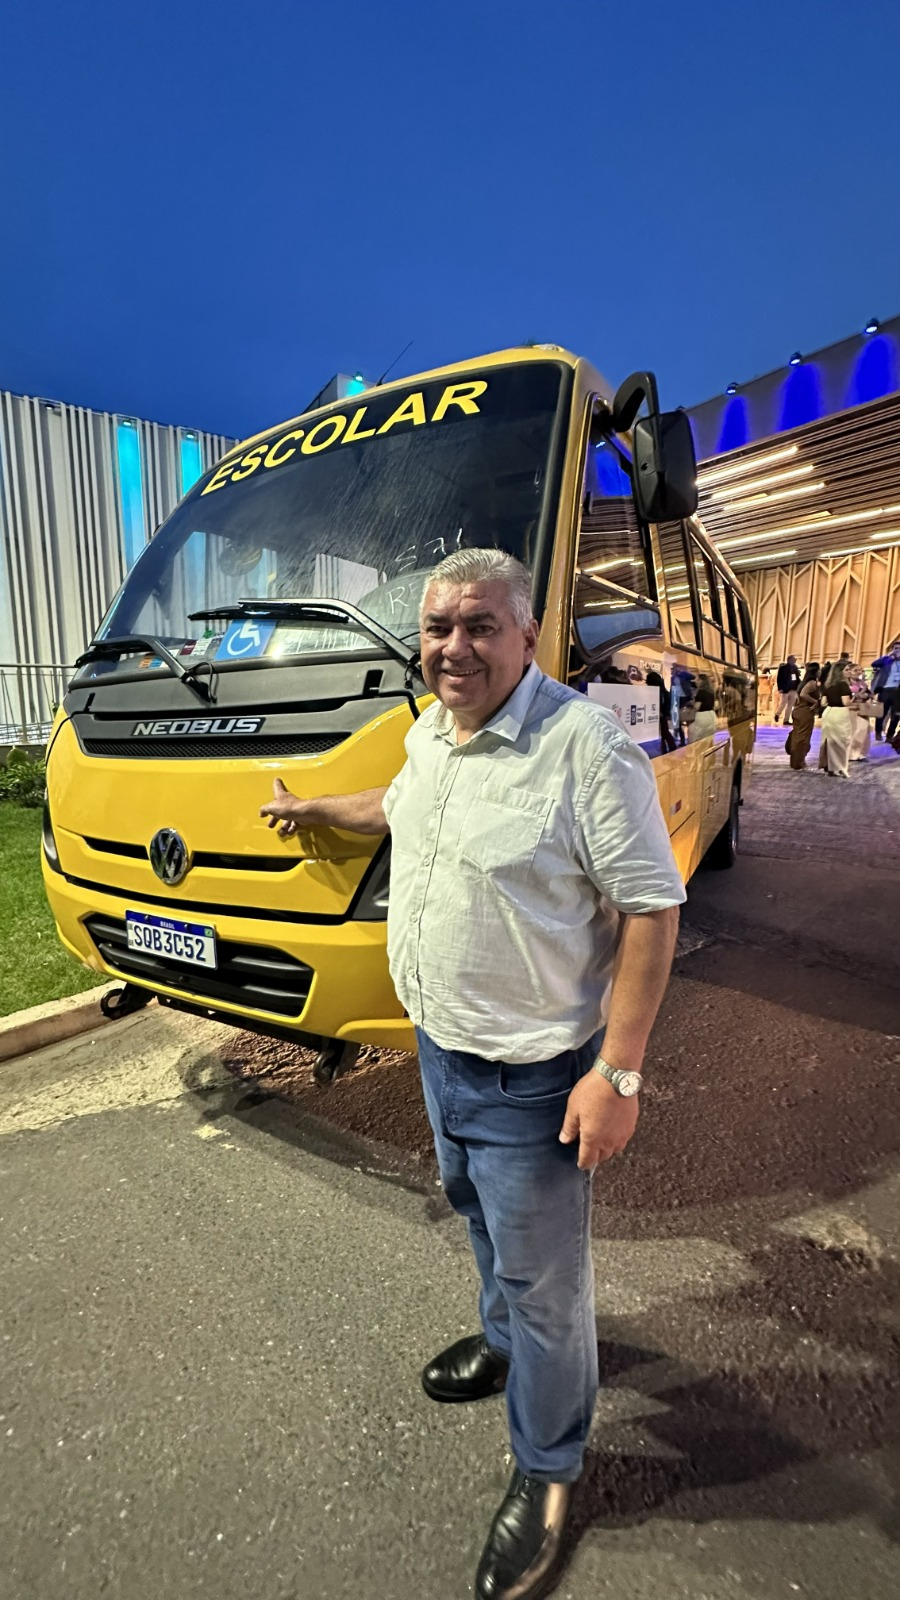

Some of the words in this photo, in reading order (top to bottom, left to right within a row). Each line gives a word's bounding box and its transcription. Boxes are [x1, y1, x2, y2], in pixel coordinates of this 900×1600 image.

[200, 380, 488, 496] ESCOLAR
[133, 718, 262, 736] NEOBUS
[160, 920, 175, 930] BRASIL
[133, 924, 206, 962] SQB3C52
